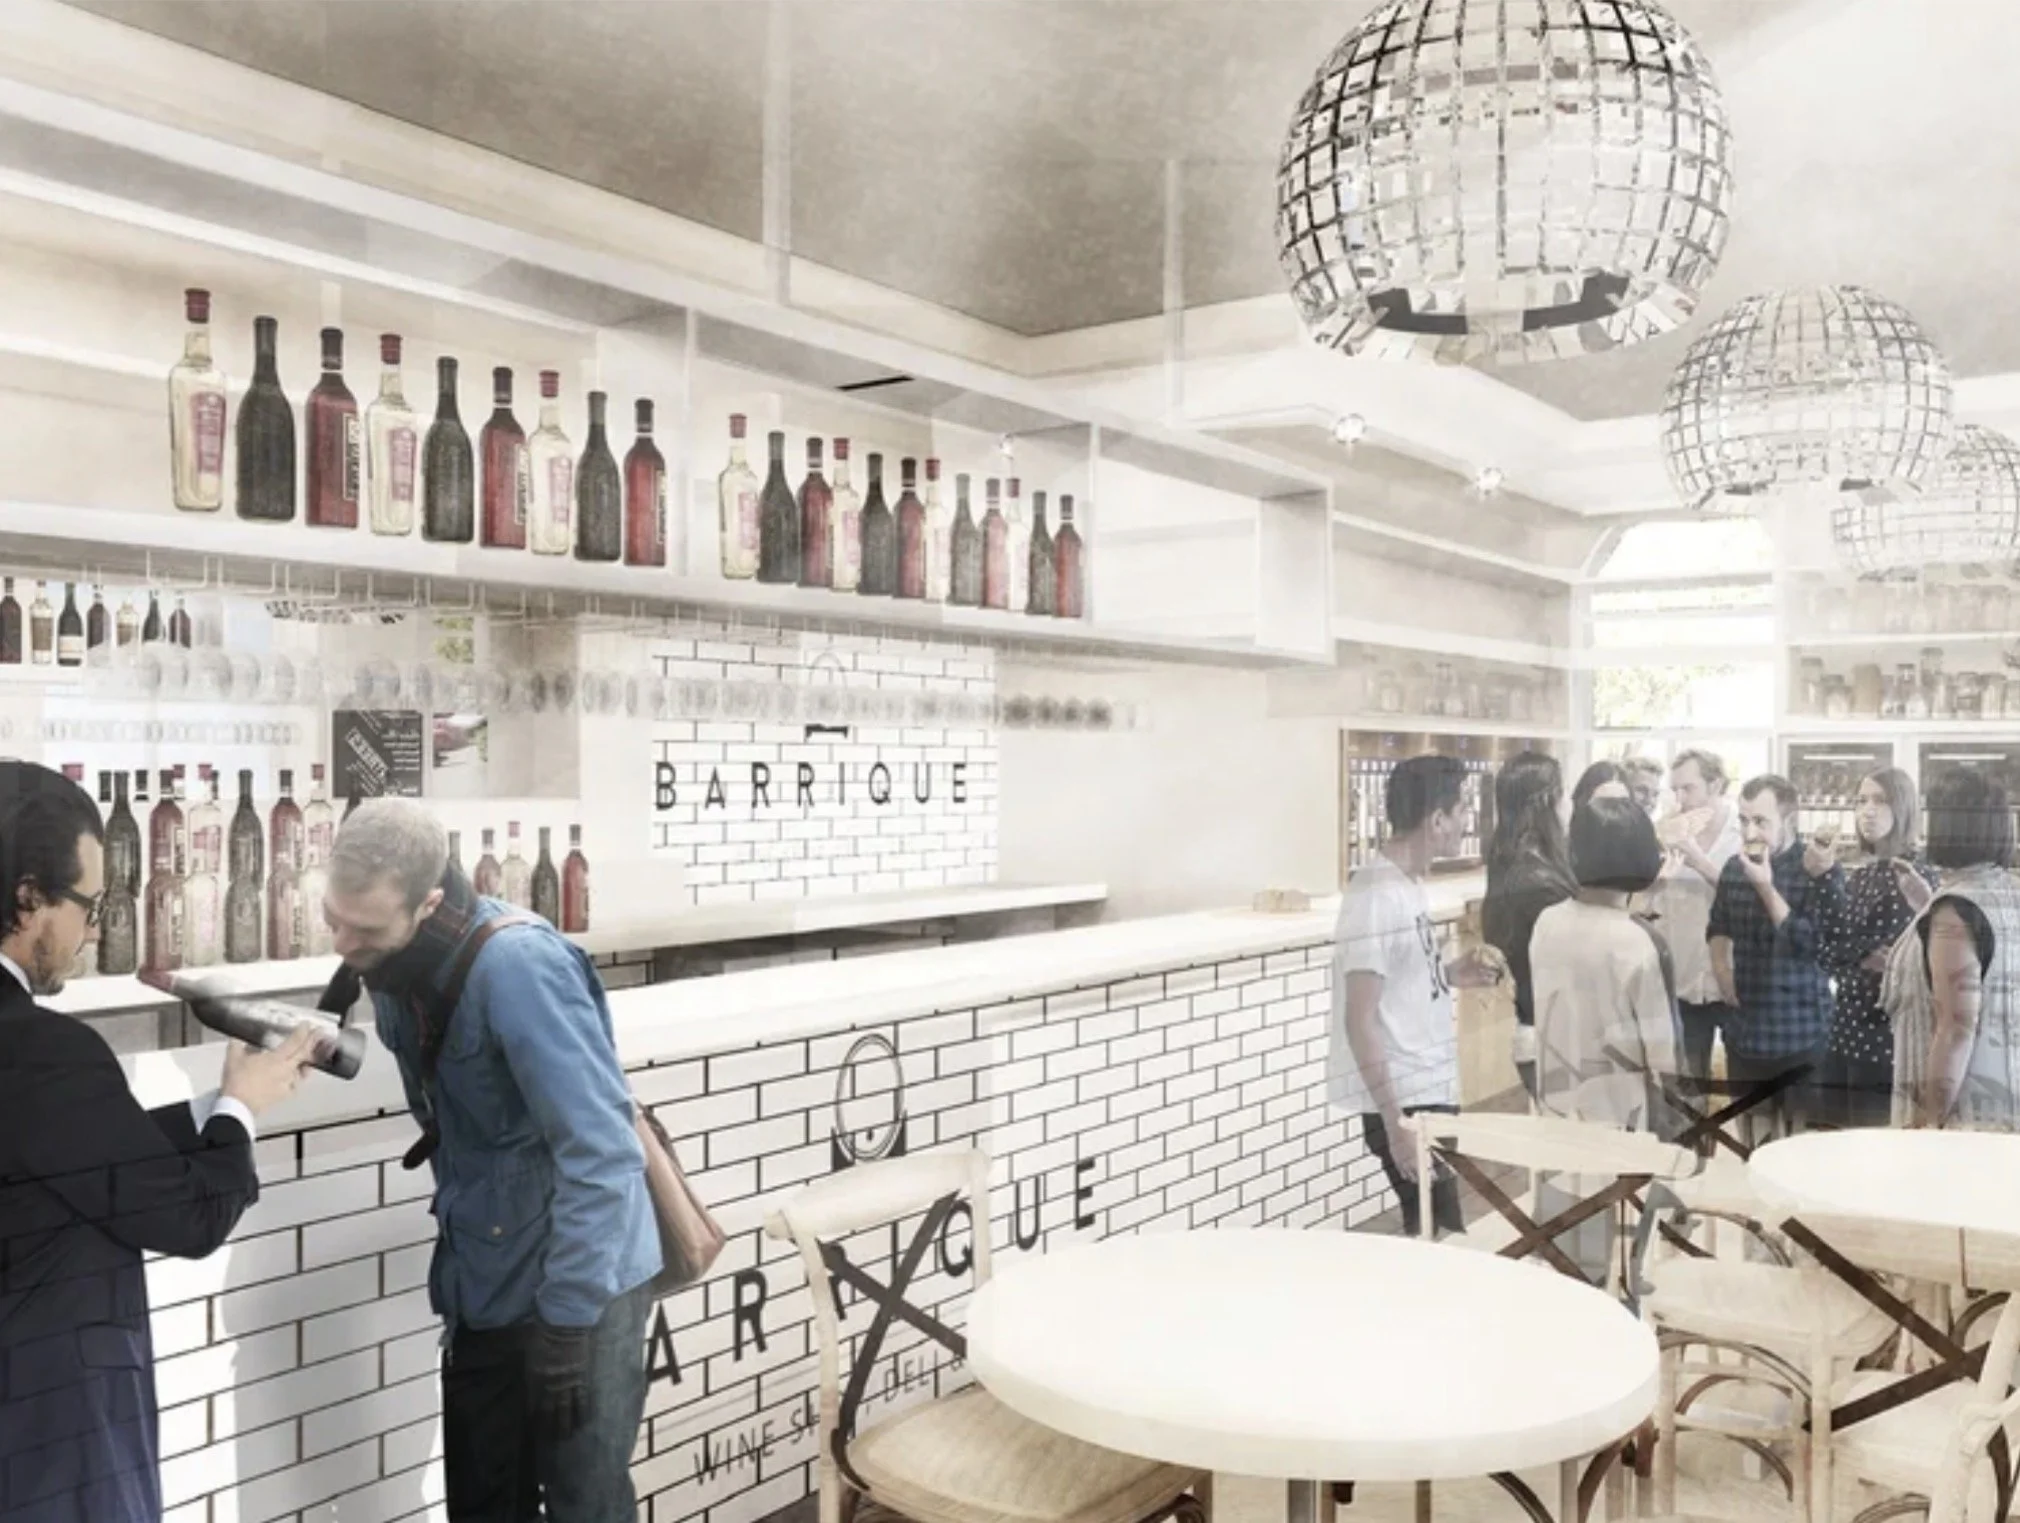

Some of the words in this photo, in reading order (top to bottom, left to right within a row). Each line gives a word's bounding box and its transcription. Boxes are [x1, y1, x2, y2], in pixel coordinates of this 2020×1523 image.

[655, 761, 967, 811] BARRIQUE
[693, 1419, 776, 1486] WINE
[884, 1349, 940, 1402] DELI
